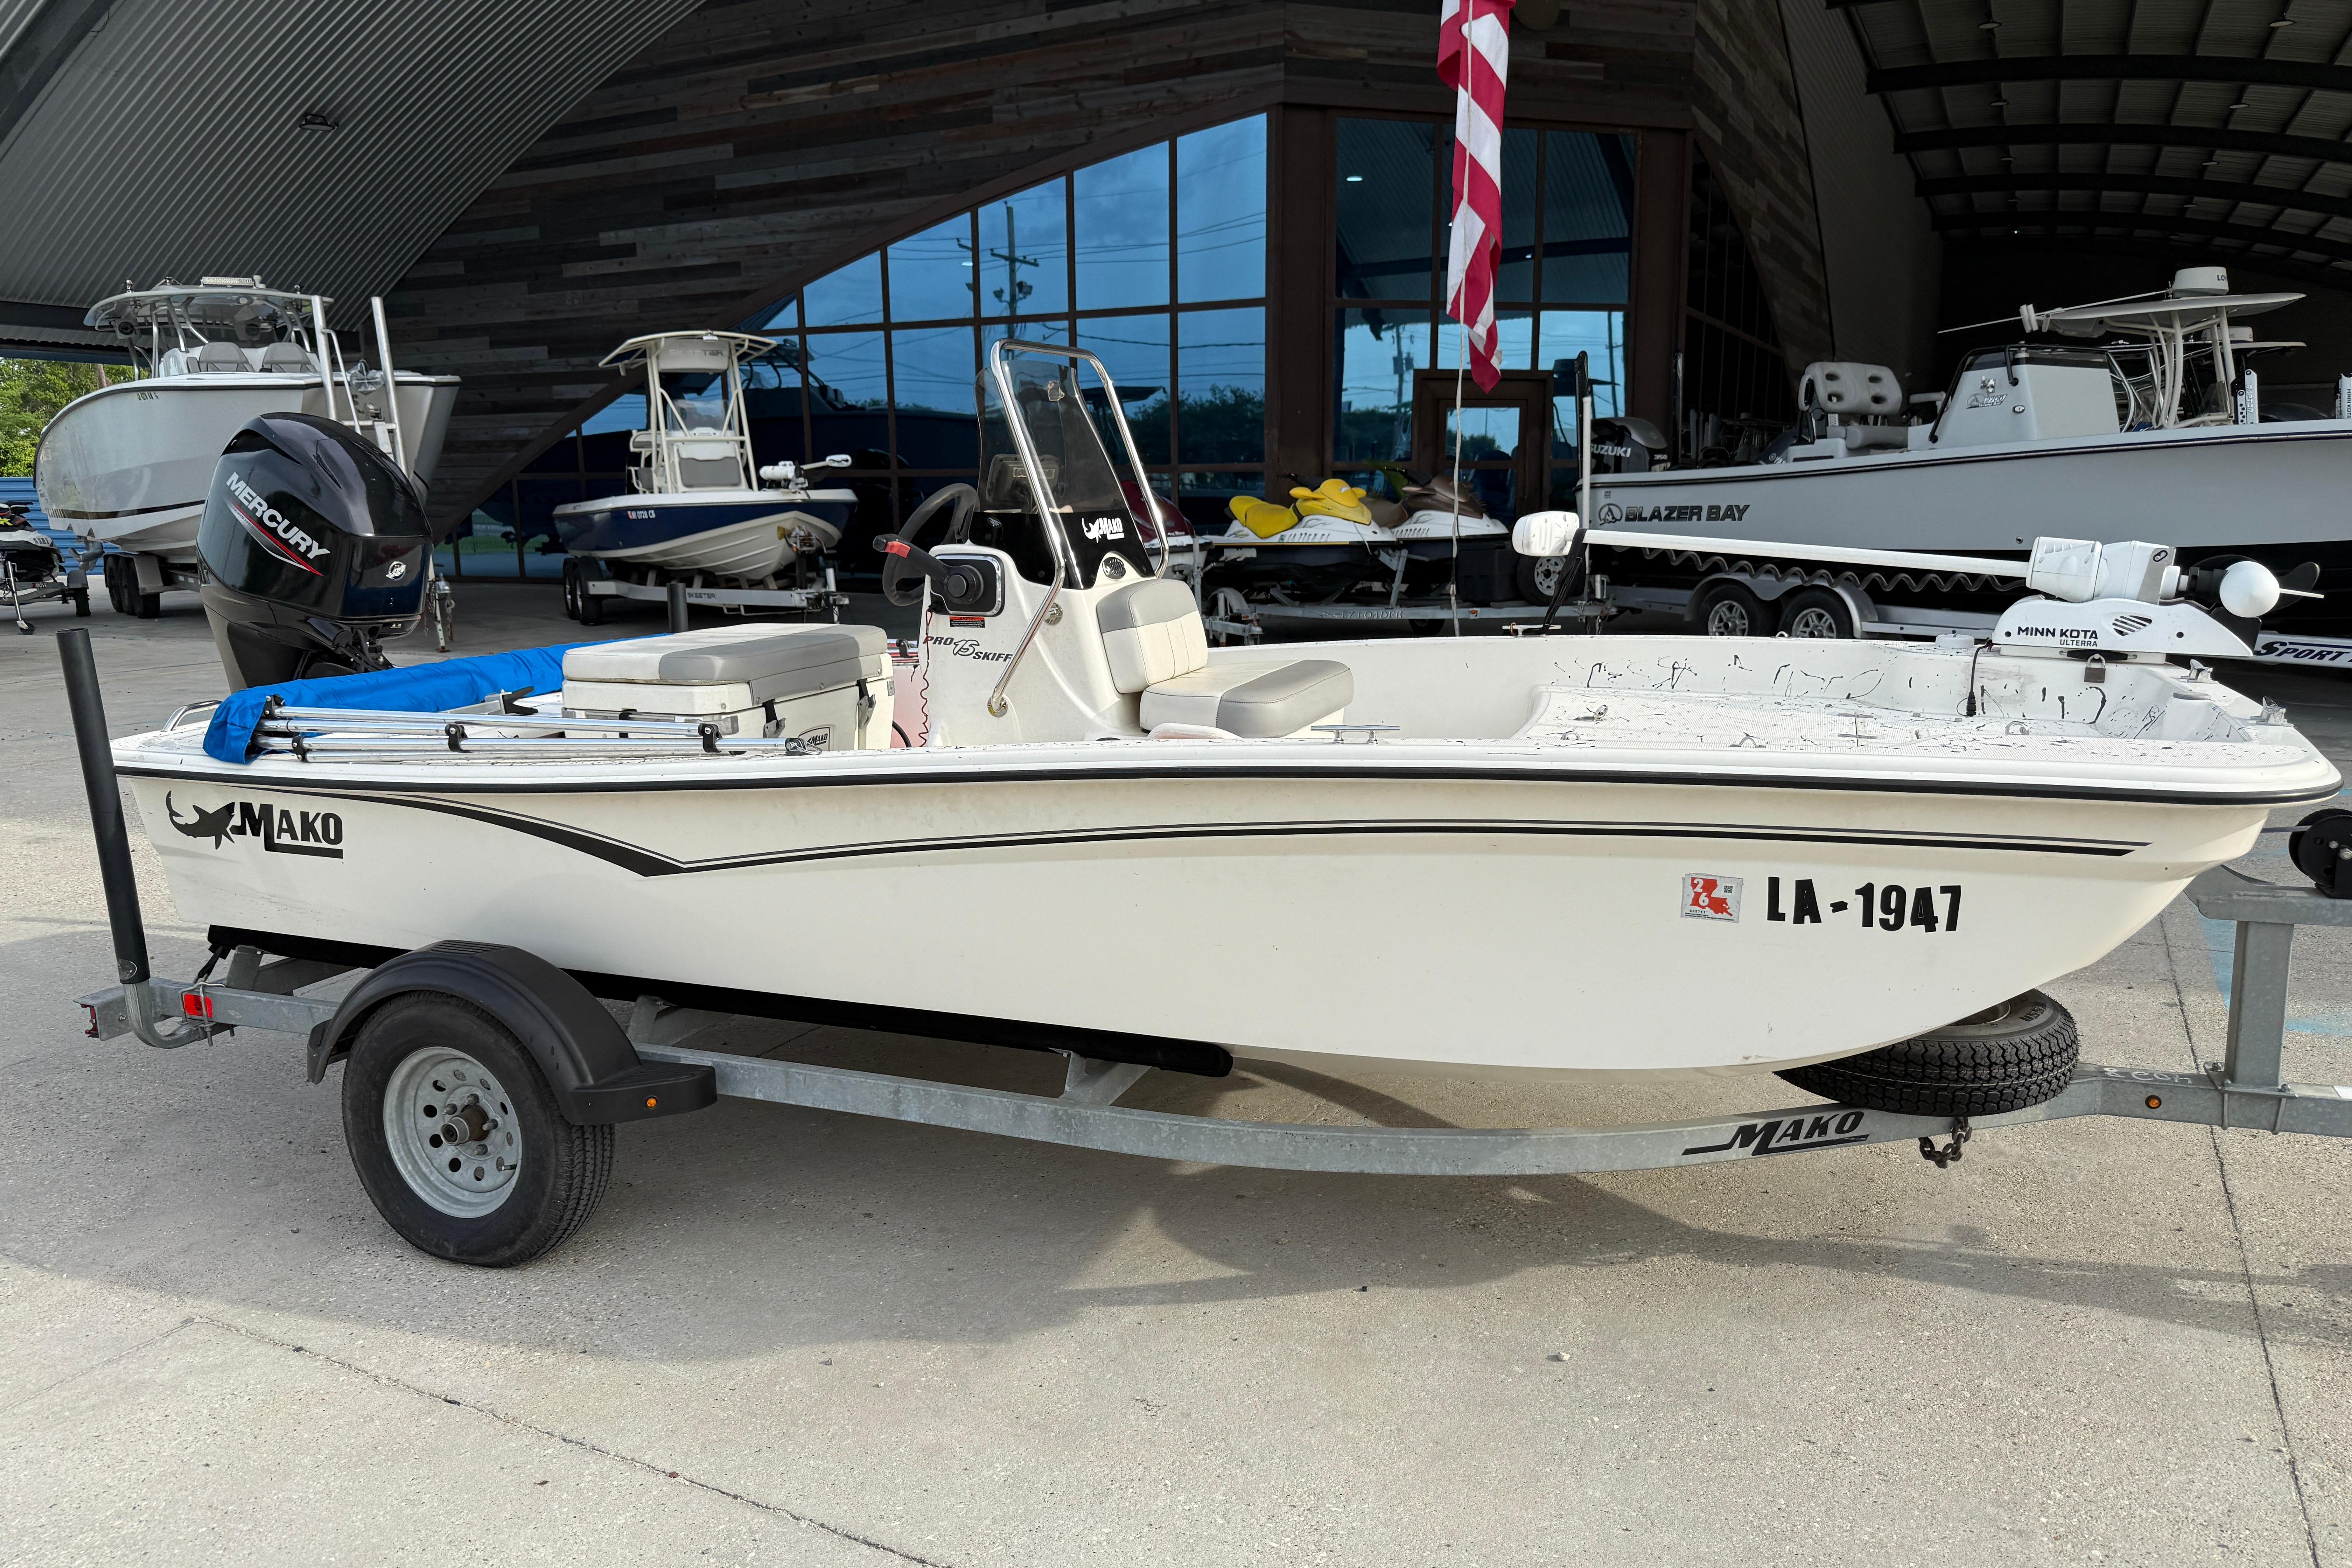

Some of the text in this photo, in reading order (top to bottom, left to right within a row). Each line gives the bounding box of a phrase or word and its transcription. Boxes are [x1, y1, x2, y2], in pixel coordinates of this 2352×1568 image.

[226, 472, 331, 560] MERCURY
[1624, 505, 1750, 522] BLAZER BAY
[1099, 517, 1125, 540] MAKO
[1358, 611, 1403, 619] LOADER
[2017, 626, 2098, 639] MINN KOTA
[923, 636, 1013, 662] PRO 15 SKIFF
[229, 801, 343, 859] MAKO
[1681, 1111, 1870, 1156] MAKO
